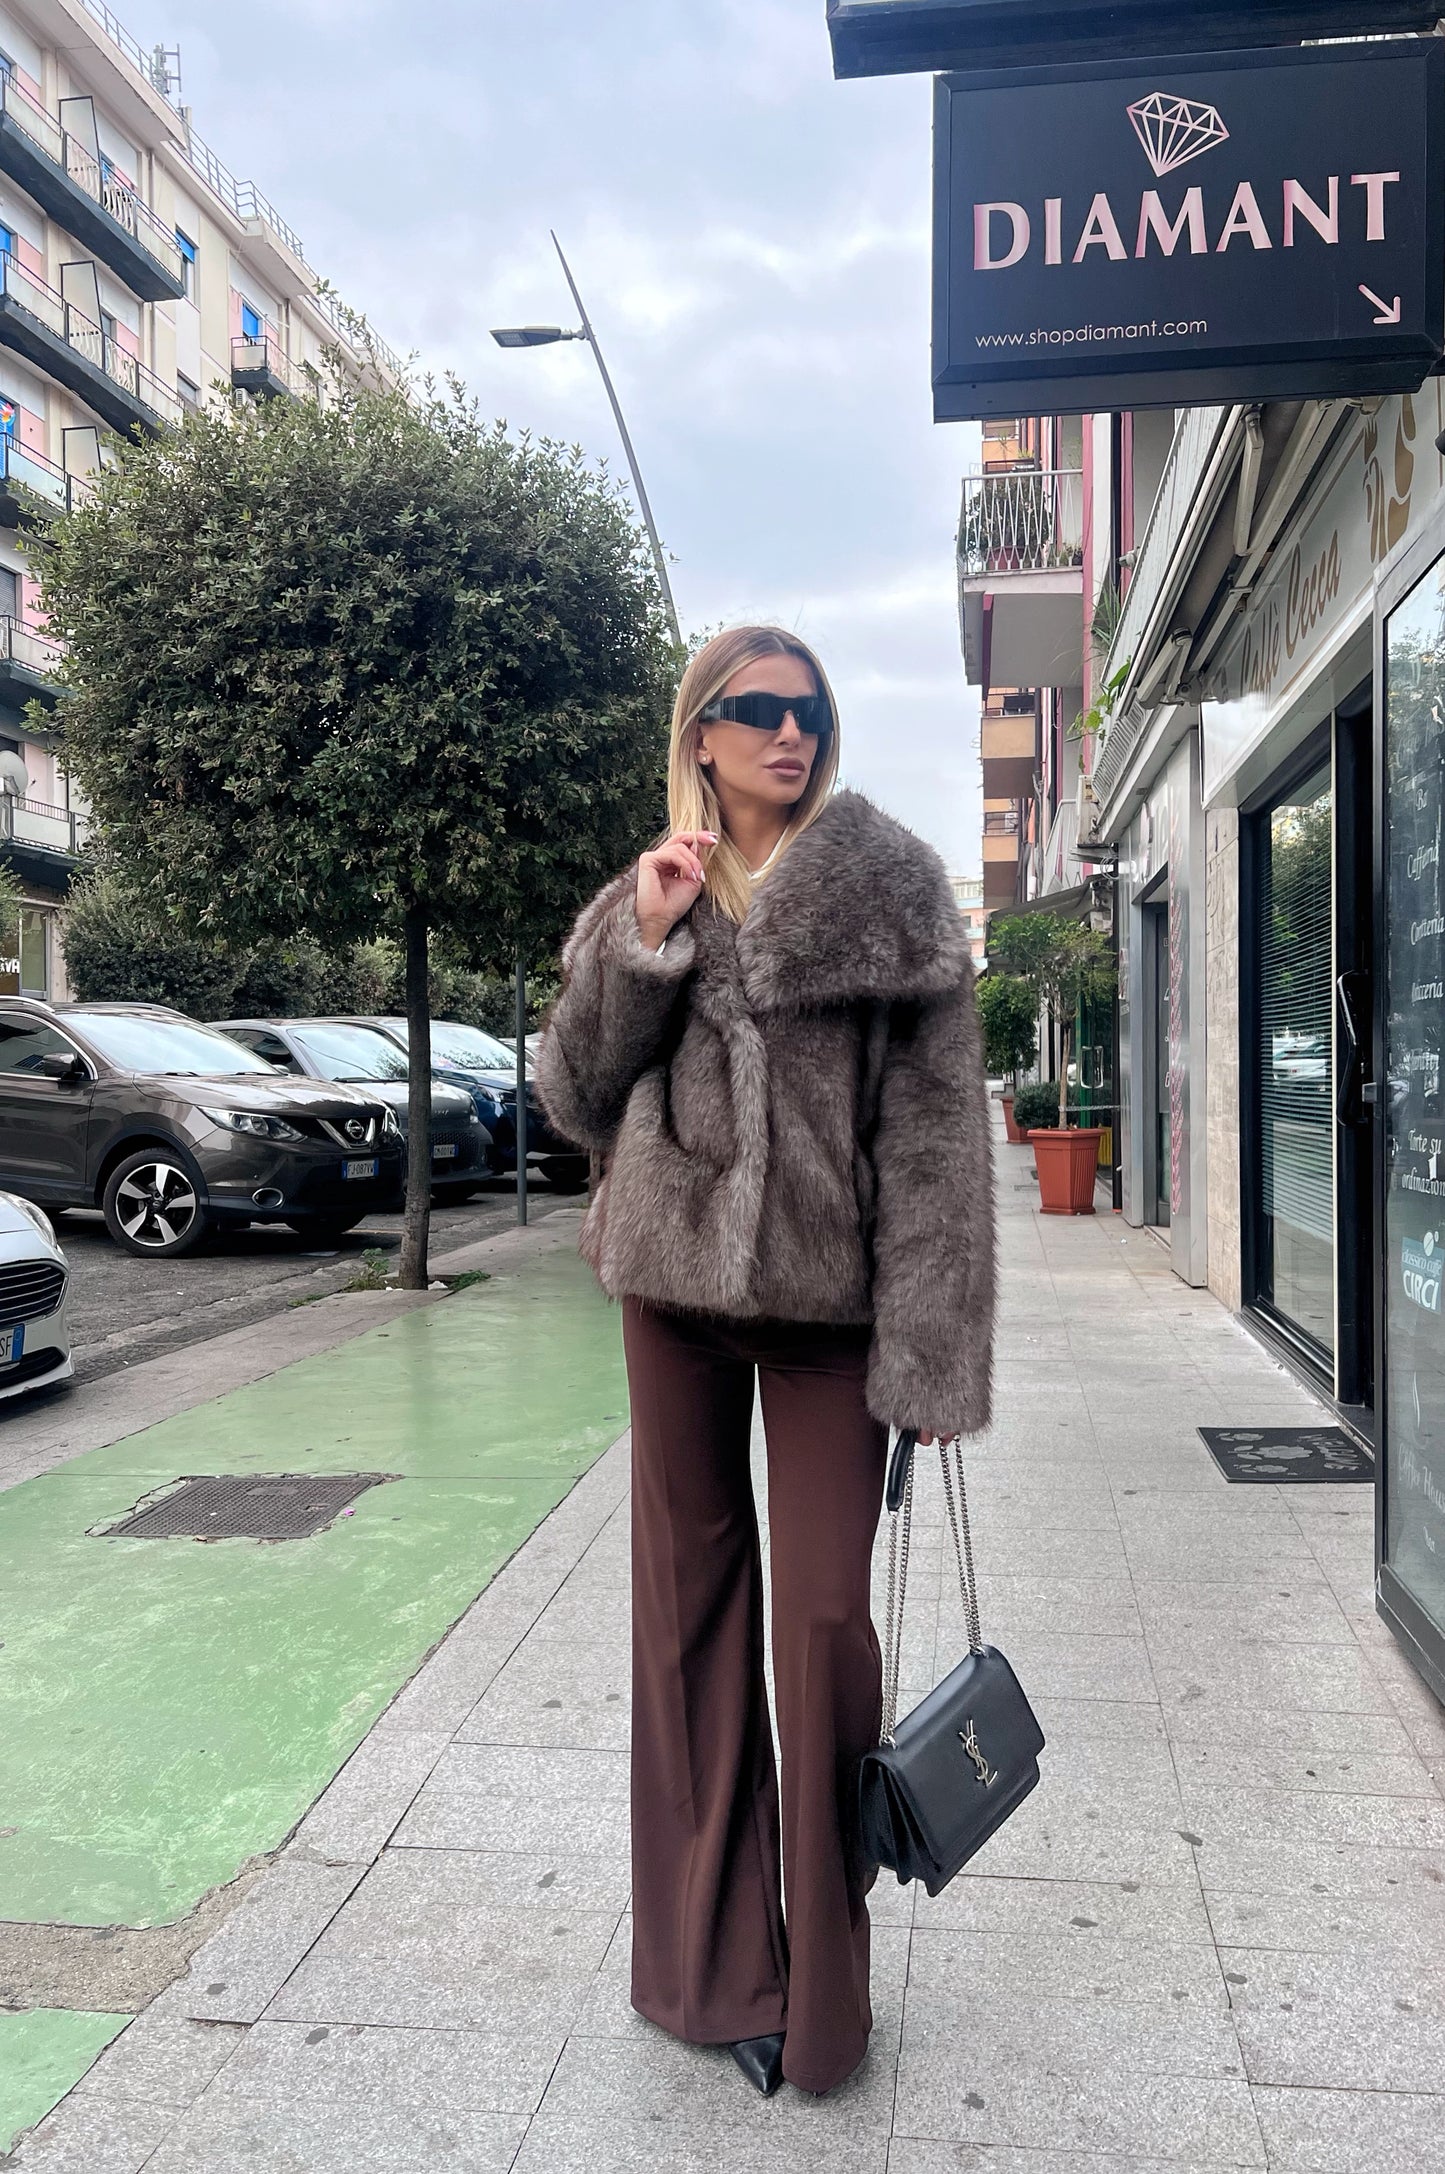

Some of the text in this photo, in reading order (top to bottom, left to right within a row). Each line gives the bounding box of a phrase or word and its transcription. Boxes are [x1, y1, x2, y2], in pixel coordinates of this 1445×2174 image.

[973, 171, 1401, 271] DIAMANT
[974, 318, 1208, 348] www.shopdiamant.com
[1403, 1270, 1439, 1310] CIRCI
[958, 1719, 998, 1787] YSL
